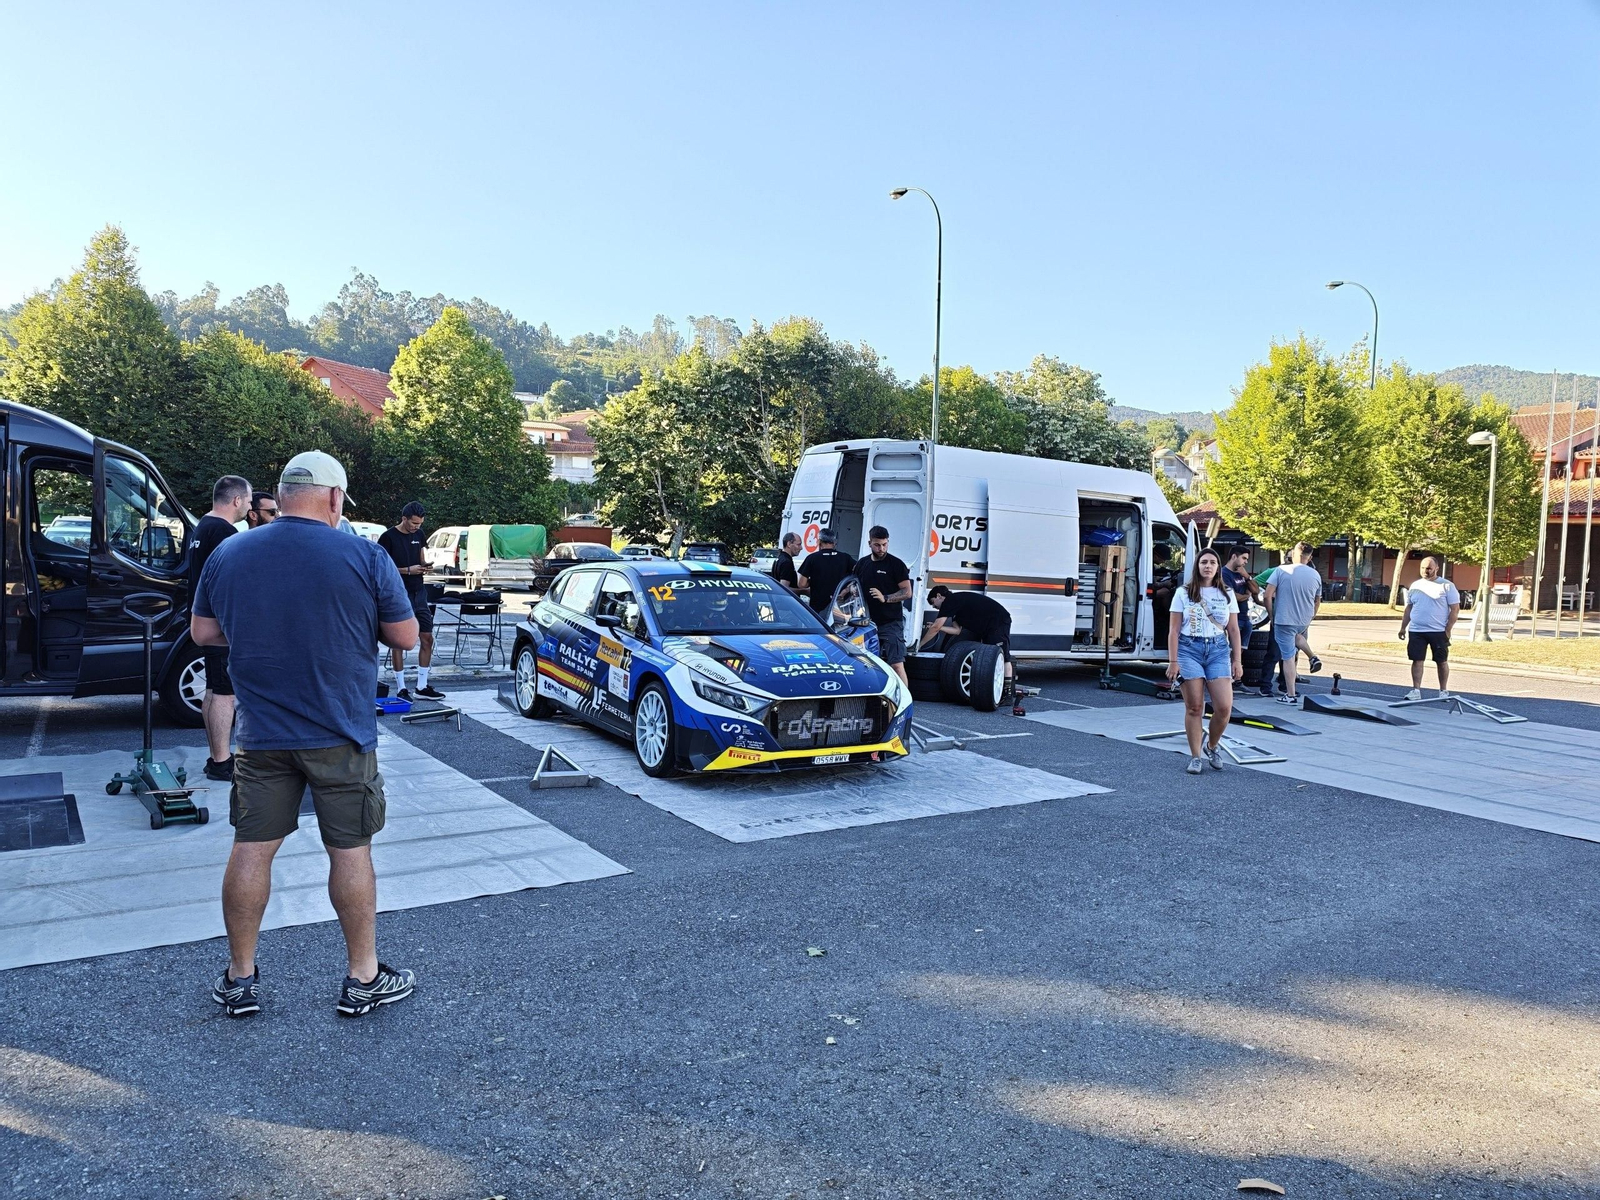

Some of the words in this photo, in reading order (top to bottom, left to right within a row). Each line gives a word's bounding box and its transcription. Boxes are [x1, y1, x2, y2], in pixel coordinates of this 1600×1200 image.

[932, 514, 988, 531] ORTS
[940, 535, 981, 552] YOU
[698, 579, 773, 591] HYUNDAI
[648, 586, 677, 601] 12
[559, 642, 598, 671] RALLYE
[561, 656, 577, 669] TEAM
[576, 665, 594, 679] SPAIN
[703, 667, 727, 683] HYUNDAI
[771, 663, 855, 673] RALLYE
[601, 701, 632, 724] FERRETERIA
[728, 749, 761, 762] PIRELLI
[346, 988, 373, 998] SALOMON
